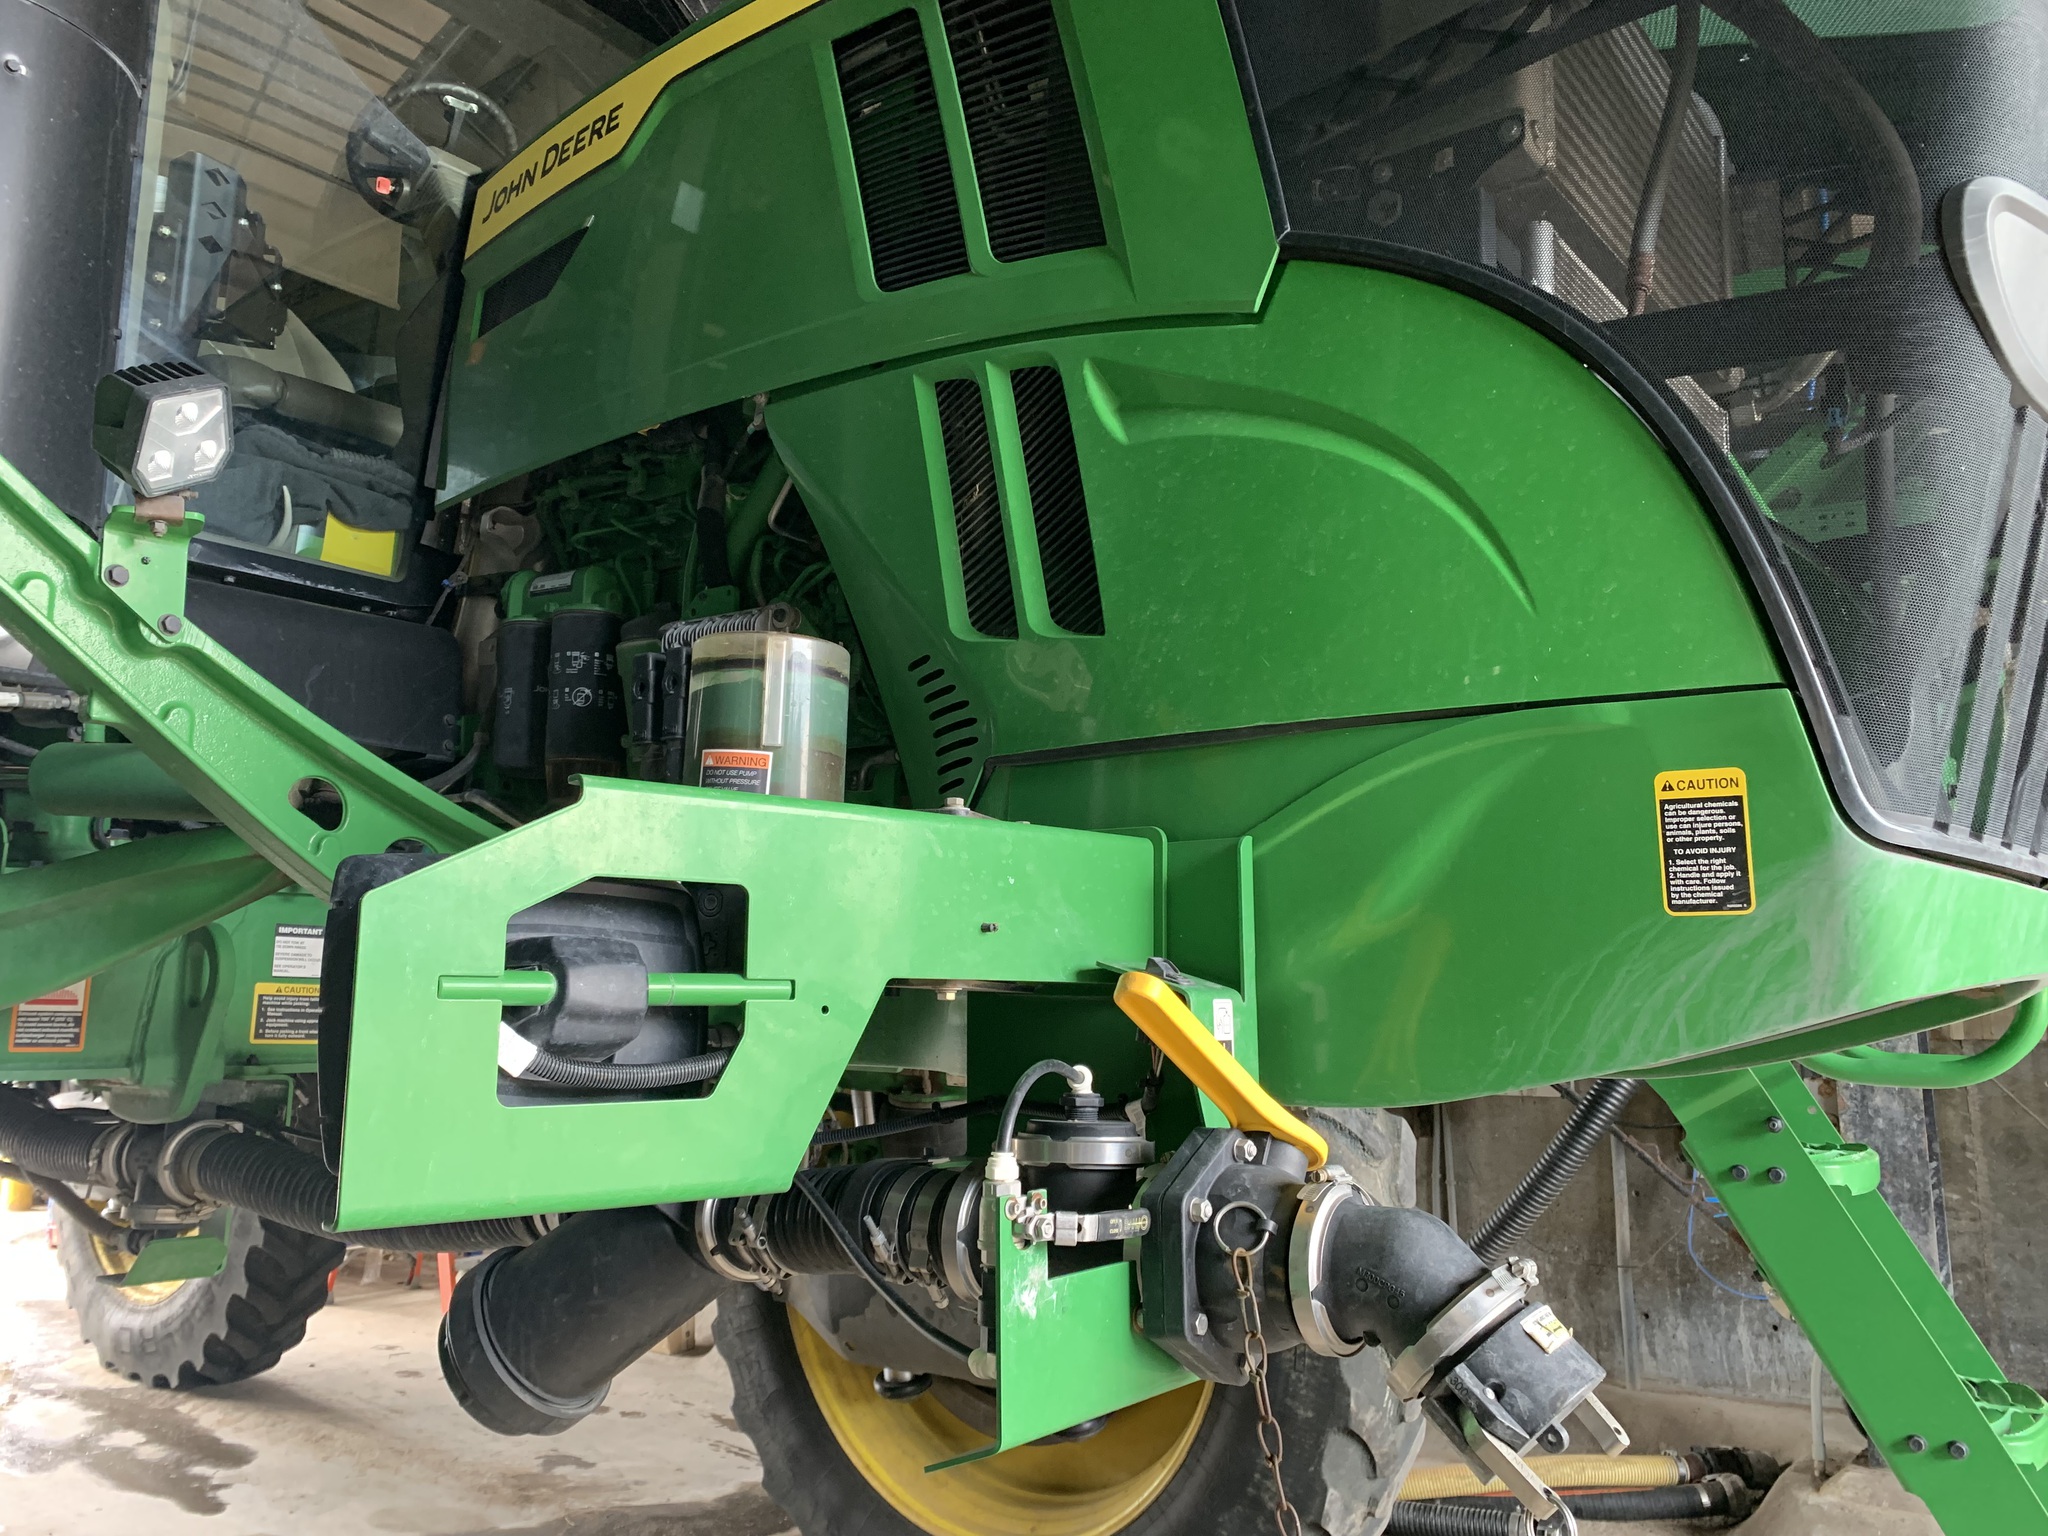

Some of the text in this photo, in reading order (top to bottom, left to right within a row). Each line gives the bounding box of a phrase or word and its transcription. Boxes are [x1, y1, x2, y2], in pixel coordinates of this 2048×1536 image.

[482, 102, 624, 224] JOHN DEERE
[715, 756, 767, 767] WARNING
[1676, 777, 1739, 791] CAUTION
[1664, 802, 1703, 810] Agricultural
[1688, 808, 1726, 816] dangerous.
[1695, 828, 1718, 836] plants,
[1724, 864, 1736, 872] job.
[279, 927, 323, 935] IMPORTANT
